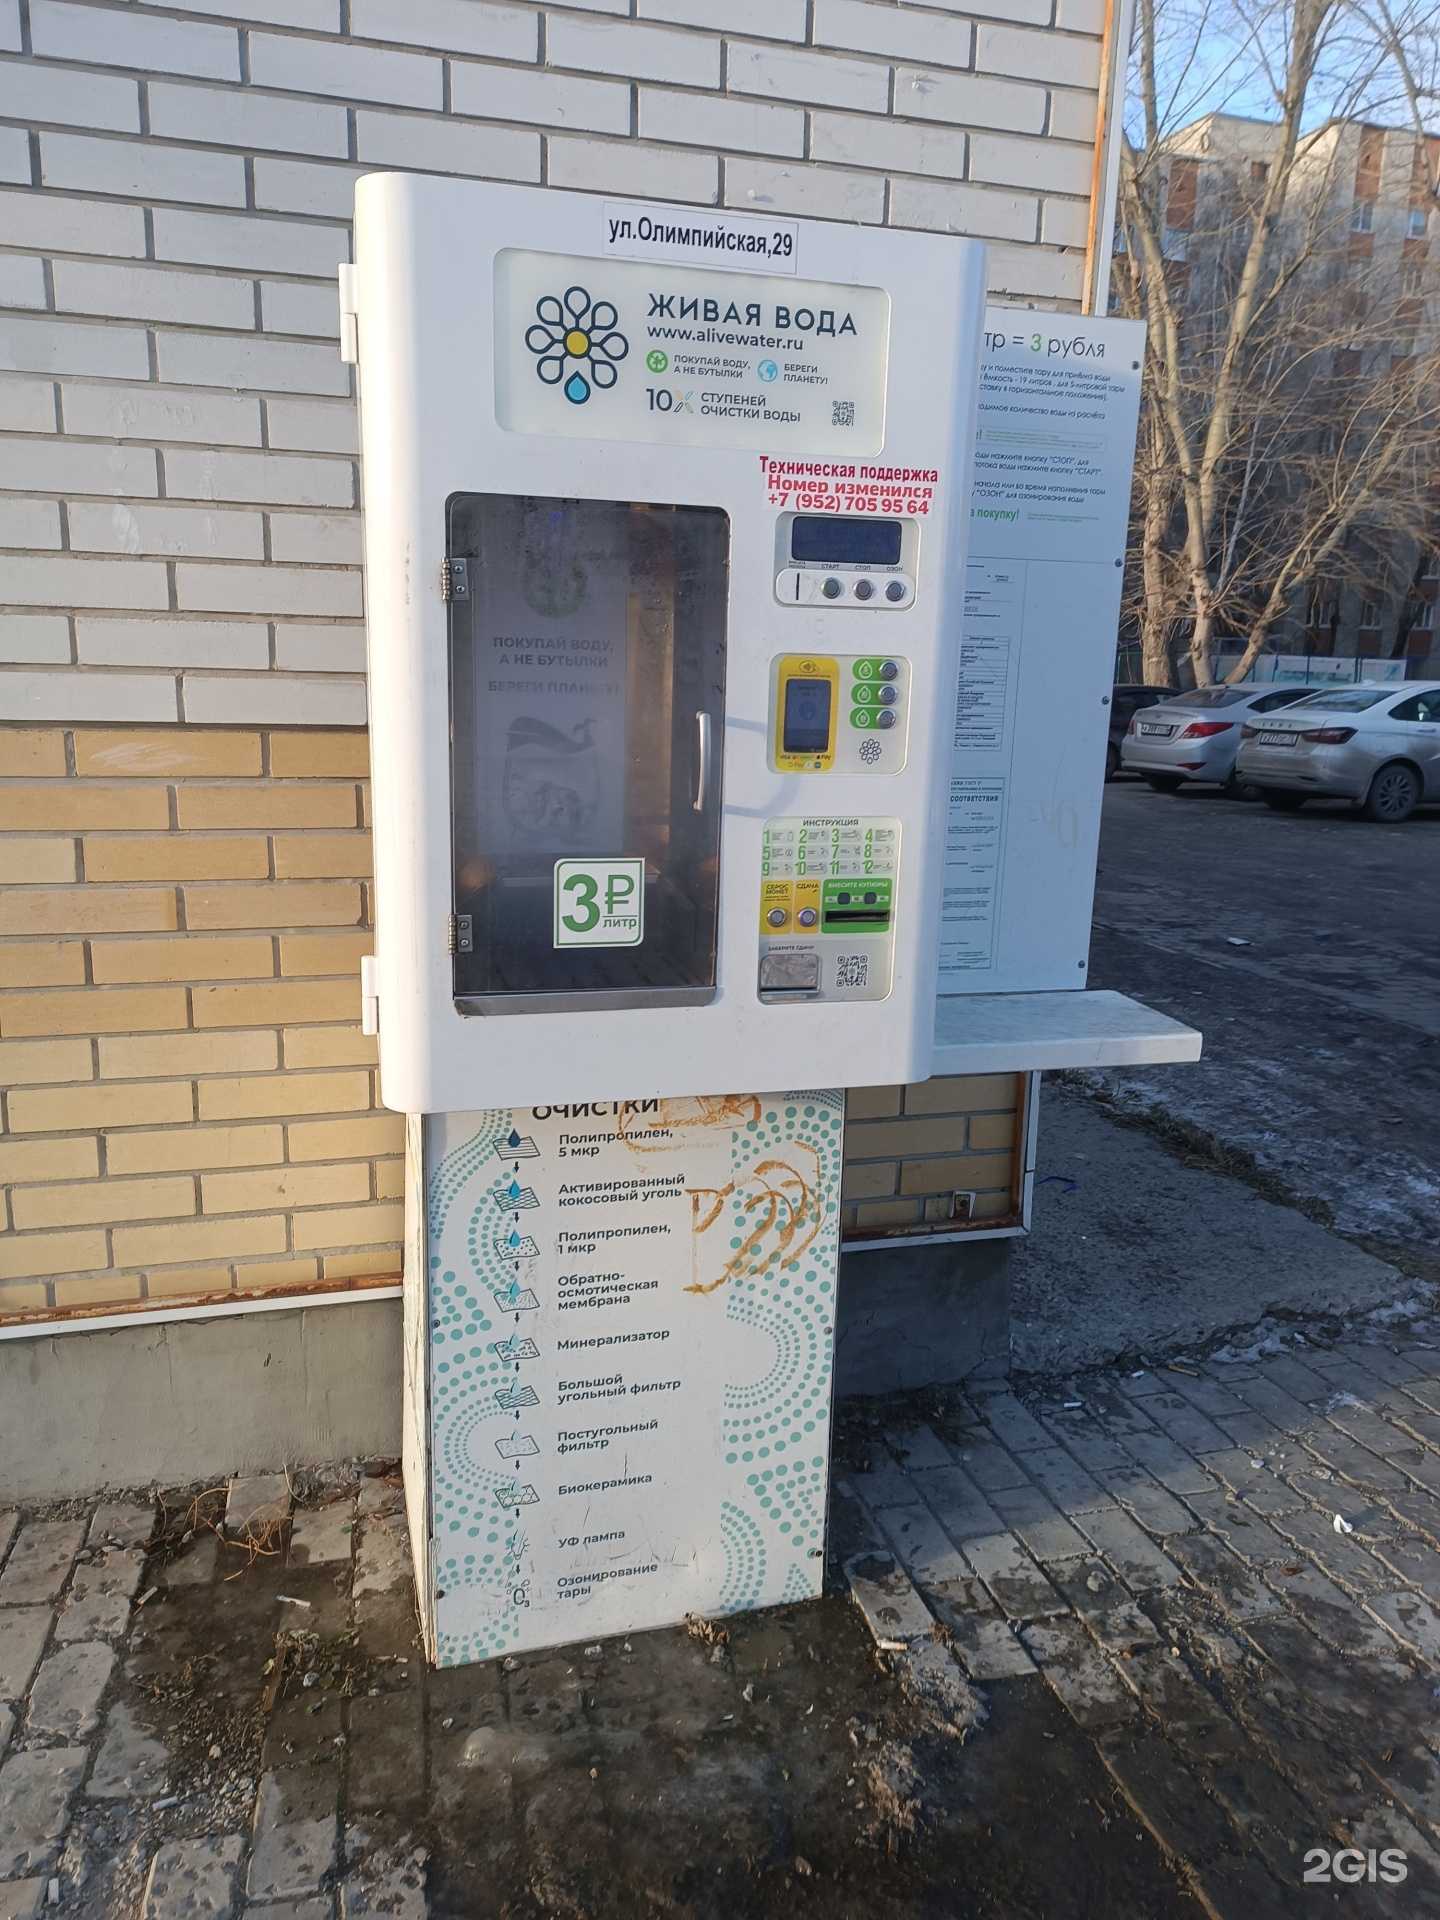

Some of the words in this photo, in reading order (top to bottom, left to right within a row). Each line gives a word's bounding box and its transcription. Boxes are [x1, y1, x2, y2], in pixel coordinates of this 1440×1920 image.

[609, 216, 793, 256] ул.Олимпийская,29
[647, 294, 761, 327] ЖИВАЯ
[775, 306, 857, 336] ВОДА
[647, 325, 803, 350] www.alivewater.ru
[1030, 333, 1042, 352] 3
[1047, 336, 1105, 359] рубля
[674, 354, 721, 367] ПОКУПАЙ
[722, 358, 751, 371] ВОДУ,
[784, 363, 818, 374] БЕРЕГИ
[674, 366, 681, 376] А
[683, 366, 696, 376] НЕ
[698, 367, 743, 378] БУТЫЛКИ
[783, 373, 828, 385] ПЛАНЕТУ!
[701, 391, 766, 407] СТУПЕНЕЙ
[701, 405, 760, 420] ОЧИСТКИ
[763, 410, 800, 422] ВОДЫ
[760, 456, 855, 478] Техническая
[860, 464, 938, 482] поддержка
[768, 475, 828, 493] Номер
[835, 482, 932, 498] изменился
[769, 493, 789, 507] +7
[796, 494, 841, 512] (952)
[845, 497, 877, 511] 705
[882, 499, 903, 513] 95
[907, 501, 929, 514] 64
[493, 637, 566, 649] ПОКУПАЙ
[498, 654, 510, 664] А
[514, 654, 533, 665] НЕ
[537, 655, 608, 667] БУТЫЛКИ
[763, 829, 770, 844] 1
[799, 829, 807, 843] 2
[832, 829, 840, 843] 3
[865, 828, 873, 843] 4
[763, 846, 770, 860] 5
[798, 845, 806, 860] 6
[831, 844, 840, 858] 7
[864, 844, 872, 858] 8
[763, 862, 770, 876] 9
[795, 861, 806, 875] 10
[830, 861, 840, 875] 11
[863, 860, 873, 874] 12
[561, 874, 601, 932] 3
[602, 916, 638, 931] литр
[532, 1098, 659, 1120] ОЧИСТКИ
[559, 1127, 674, 1146] Полипропилен,
[558, 1146, 566, 1157] 5
[570, 1146, 600, 1159] мкр
[558, 1174, 685, 1195] Активированный
[558, 1189, 638, 1207] кокосовый
[641, 1186, 682, 1202] уголь
[558, 1223, 672, 1242] Полипропилен,
[557, 1244, 563, 1255] 1
[566, 1243, 596, 1256] мкр
[558, 1270, 625, 1287] Обратно-
[558, 1282, 658, 1298] осмотическая
[558, 1295, 630, 1311] мембрана
[557, 1328, 670, 1351] Минерализатор
[558, 1373, 623, 1391] Большой
[558, 1386, 627, 1405] угольный
[630, 1378, 681, 1396] фильтр
[558, 1420, 658, 1442] Постугольный
[557, 1438, 609, 1455] фильтр
[558, 1474, 652, 1496] Биокерамика
[558, 1536, 578, 1549] УФ
[581, 1530, 626, 1545] лампа
[557, 1562, 658, 1588] Озонирование
[557, 1585, 591, 1600] тары
